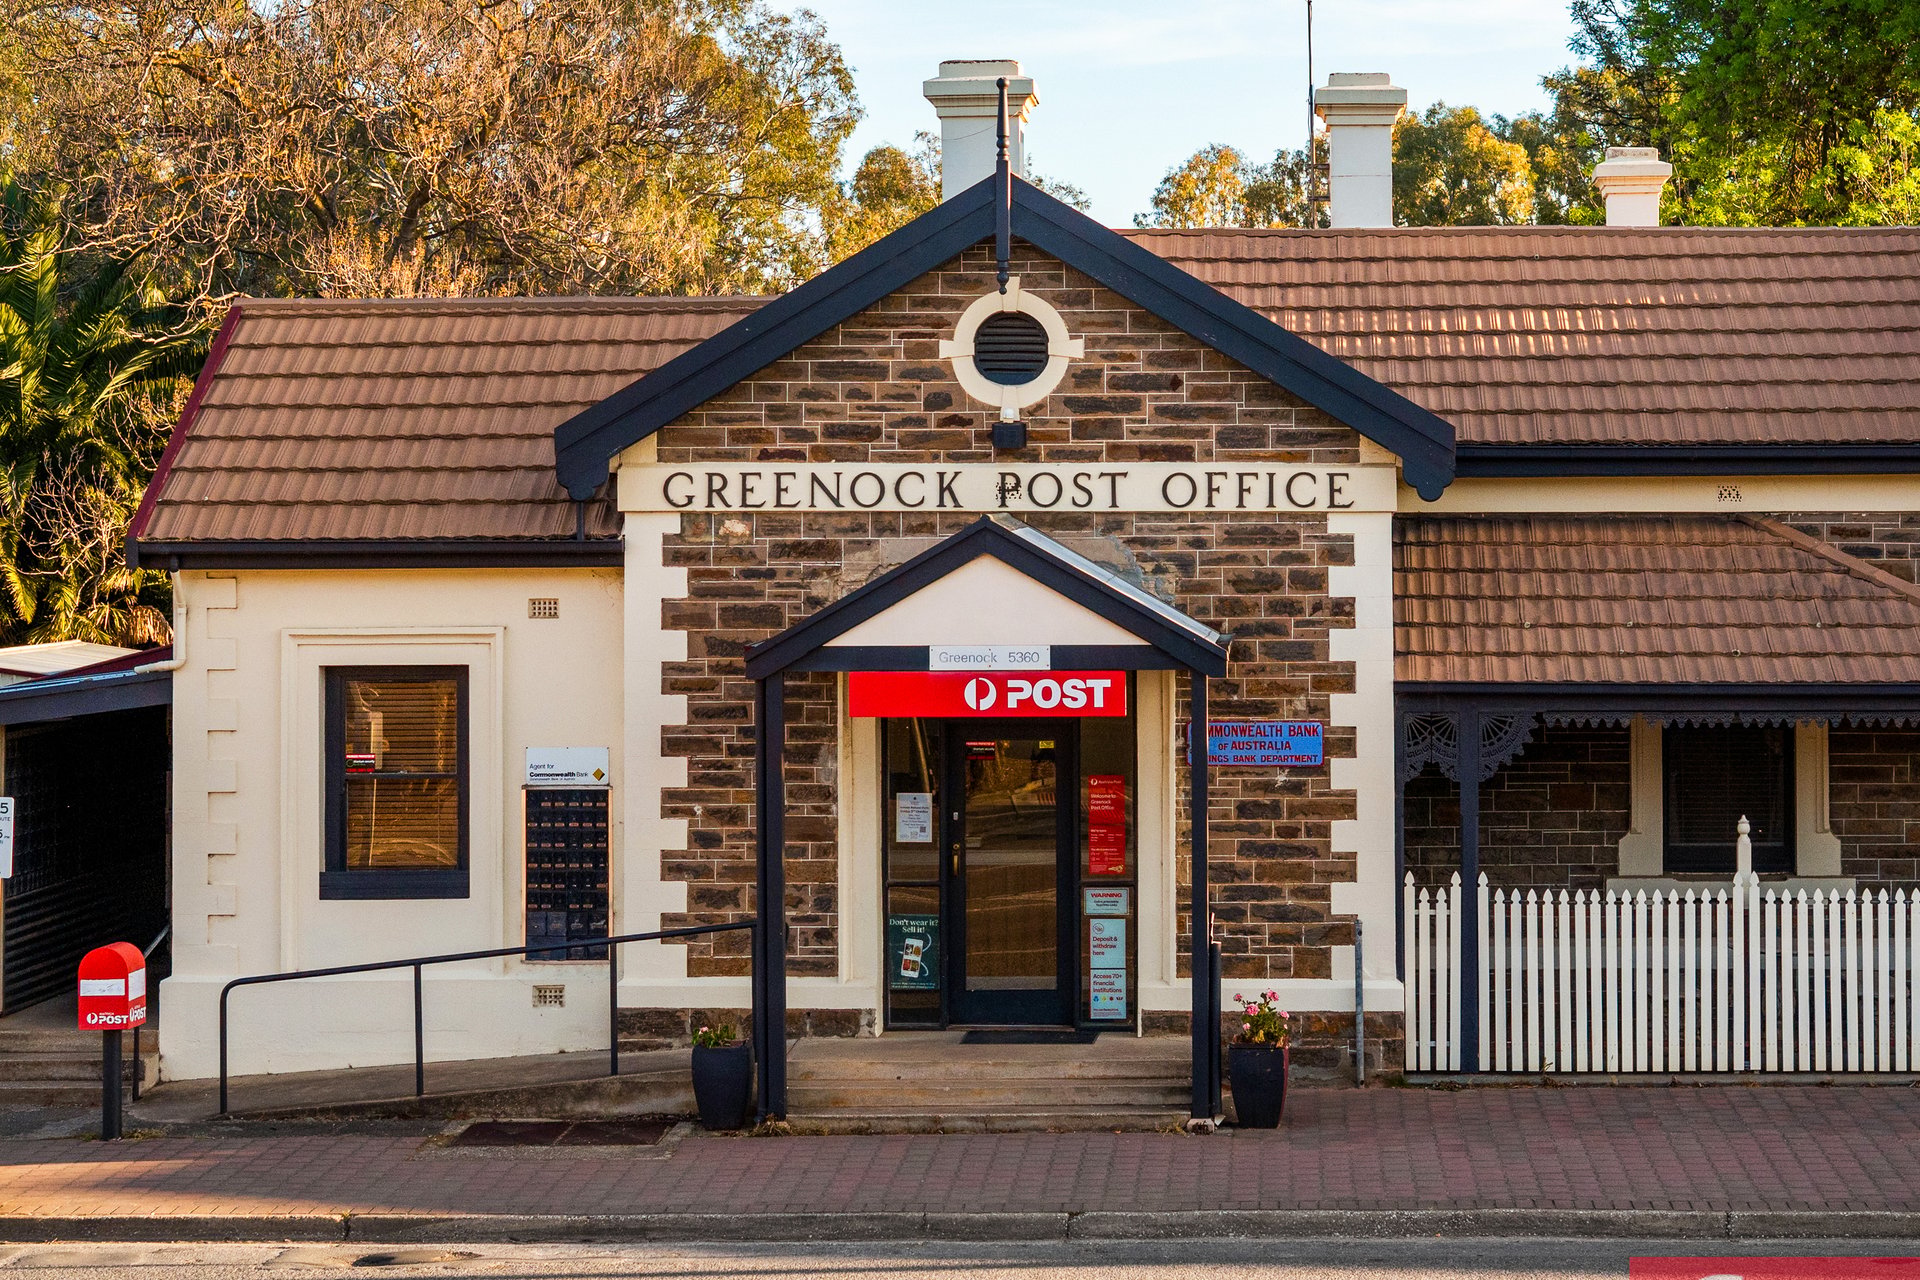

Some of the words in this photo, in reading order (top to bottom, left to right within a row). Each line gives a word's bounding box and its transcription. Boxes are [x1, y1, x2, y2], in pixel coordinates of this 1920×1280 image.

[662, 470, 964, 508] GREENOCK
[999, 470, 1130, 508] POST
[1162, 471, 1355, 508] OFFICE
[938, 651, 998, 663] Greenock
[1008, 651, 1040, 663] 5360
[1007, 678, 1112, 709] POST
[1208, 724, 1283, 738] MMONWEALTH
[1288, 724, 1320, 737] BANK
[1218, 743, 1229, 751] OF
[1231, 741, 1292, 751] AUSTRALIA
[1208, 754, 1229, 763] INGS
[1233, 754, 1256, 763] BANK
[1261, 754, 1318, 763] DEPARTMENT
[889, 918, 909, 926] Don't
[929, 918, 939, 926] it?
[98, 1015, 129, 1024] POST
[134, 1006, 147, 1021] POST
